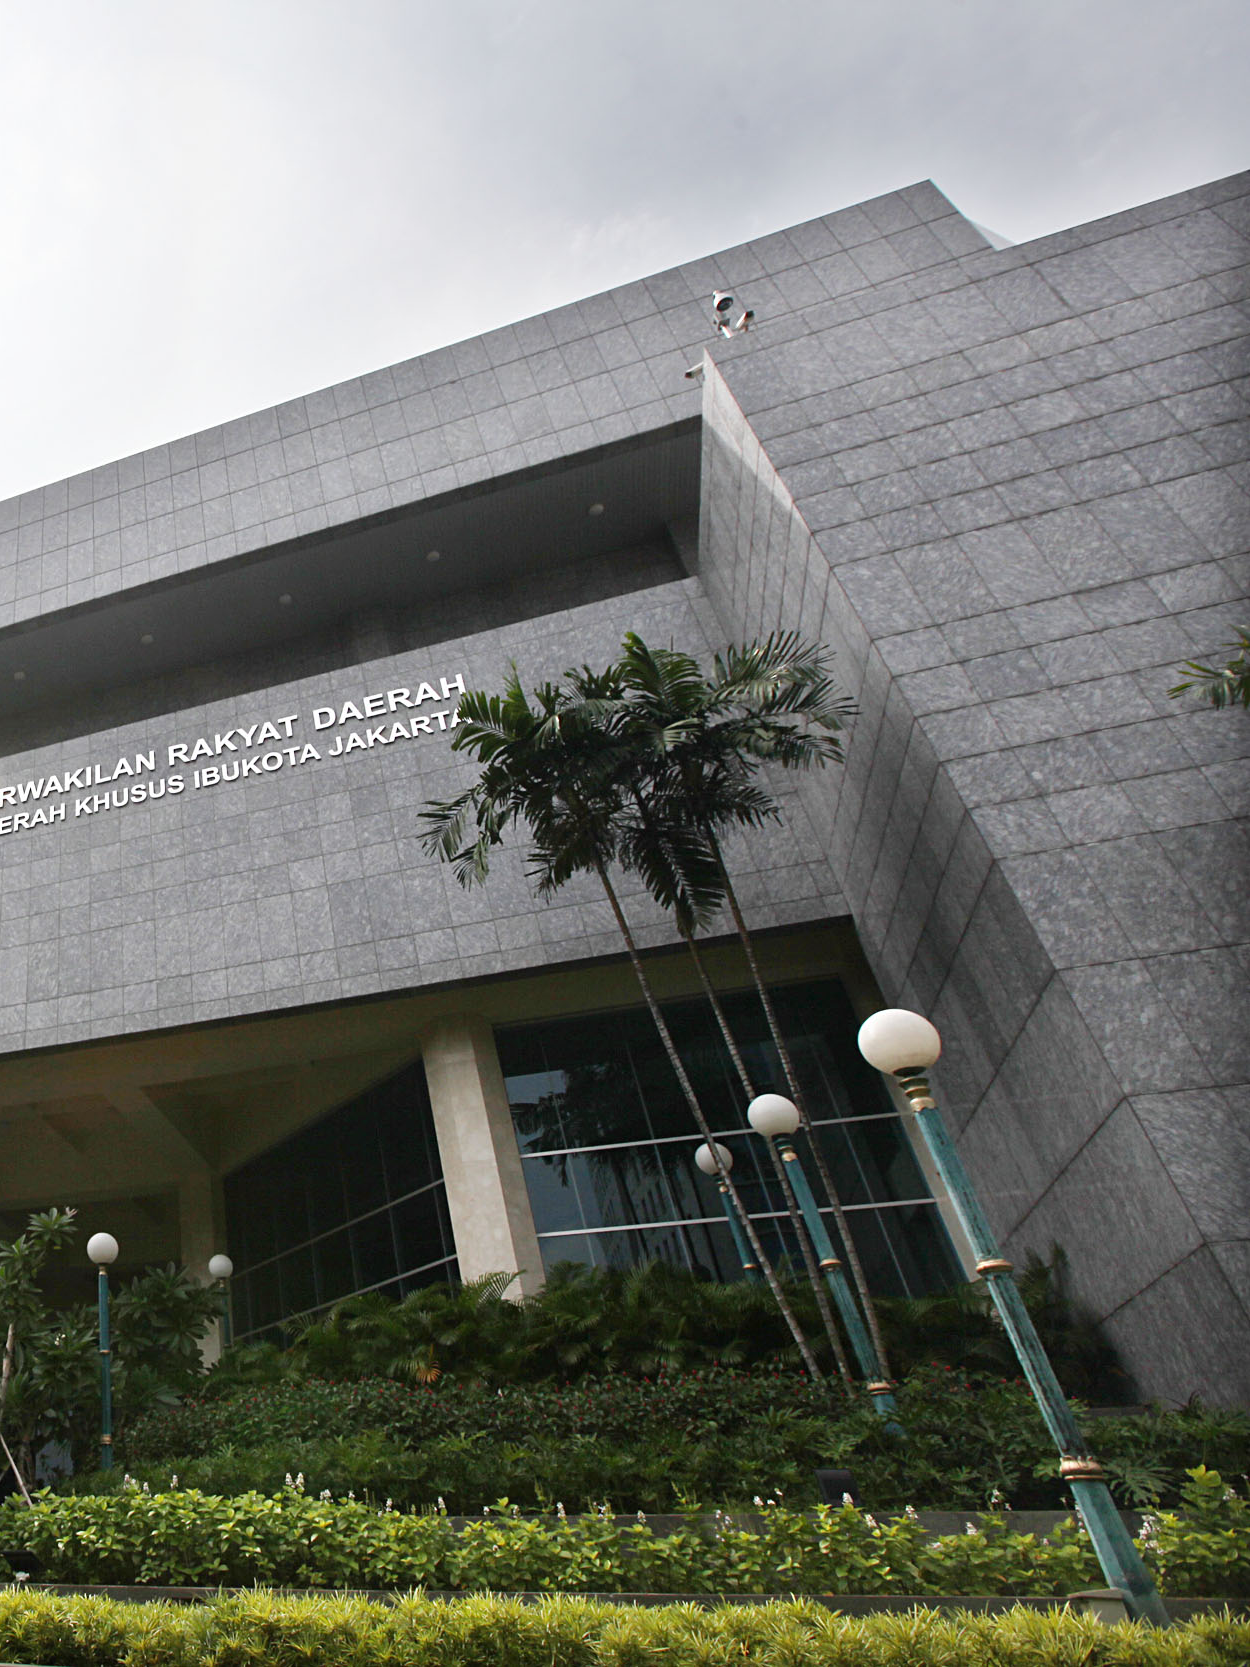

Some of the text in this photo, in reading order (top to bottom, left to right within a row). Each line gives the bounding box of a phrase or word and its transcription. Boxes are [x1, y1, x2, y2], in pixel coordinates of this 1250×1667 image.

[75, 774, 185, 817] KHUSUS
[193, 743, 321, 788] IBUKOTA
[328, 707, 473, 756] JAKARTA
[168, 714, 298, 766] RAKYAT
[312, 673, 466, 730] DAERAH
